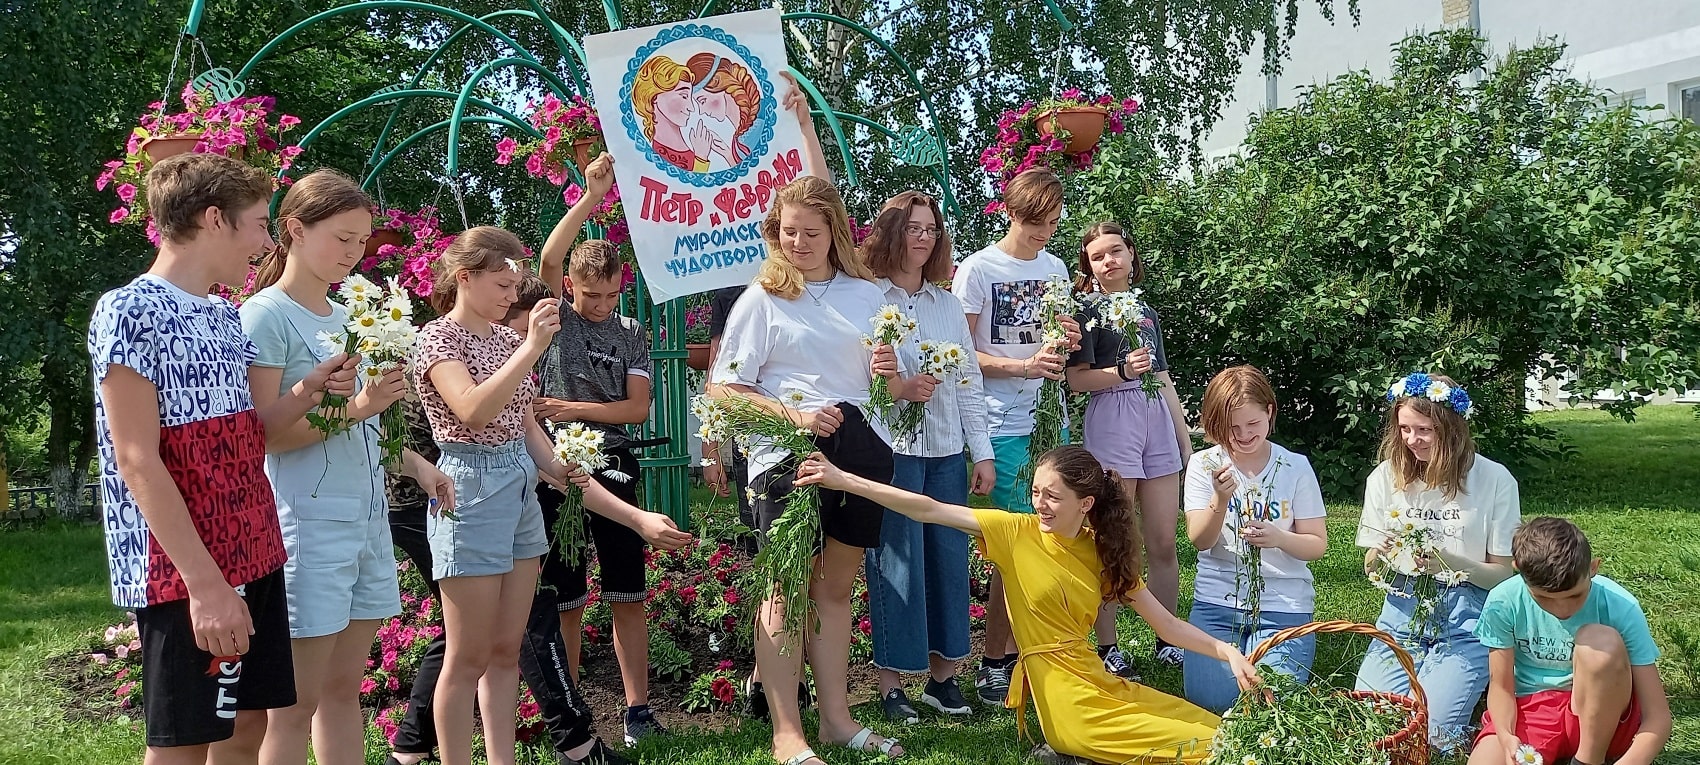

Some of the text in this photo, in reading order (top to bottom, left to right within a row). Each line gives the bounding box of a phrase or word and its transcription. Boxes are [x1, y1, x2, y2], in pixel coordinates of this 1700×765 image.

[674, 220, 763, 255] МУРОМСК
[1405, 507, 1461, 521] CANCER
[1532, 636, 1556, 647] NEW
